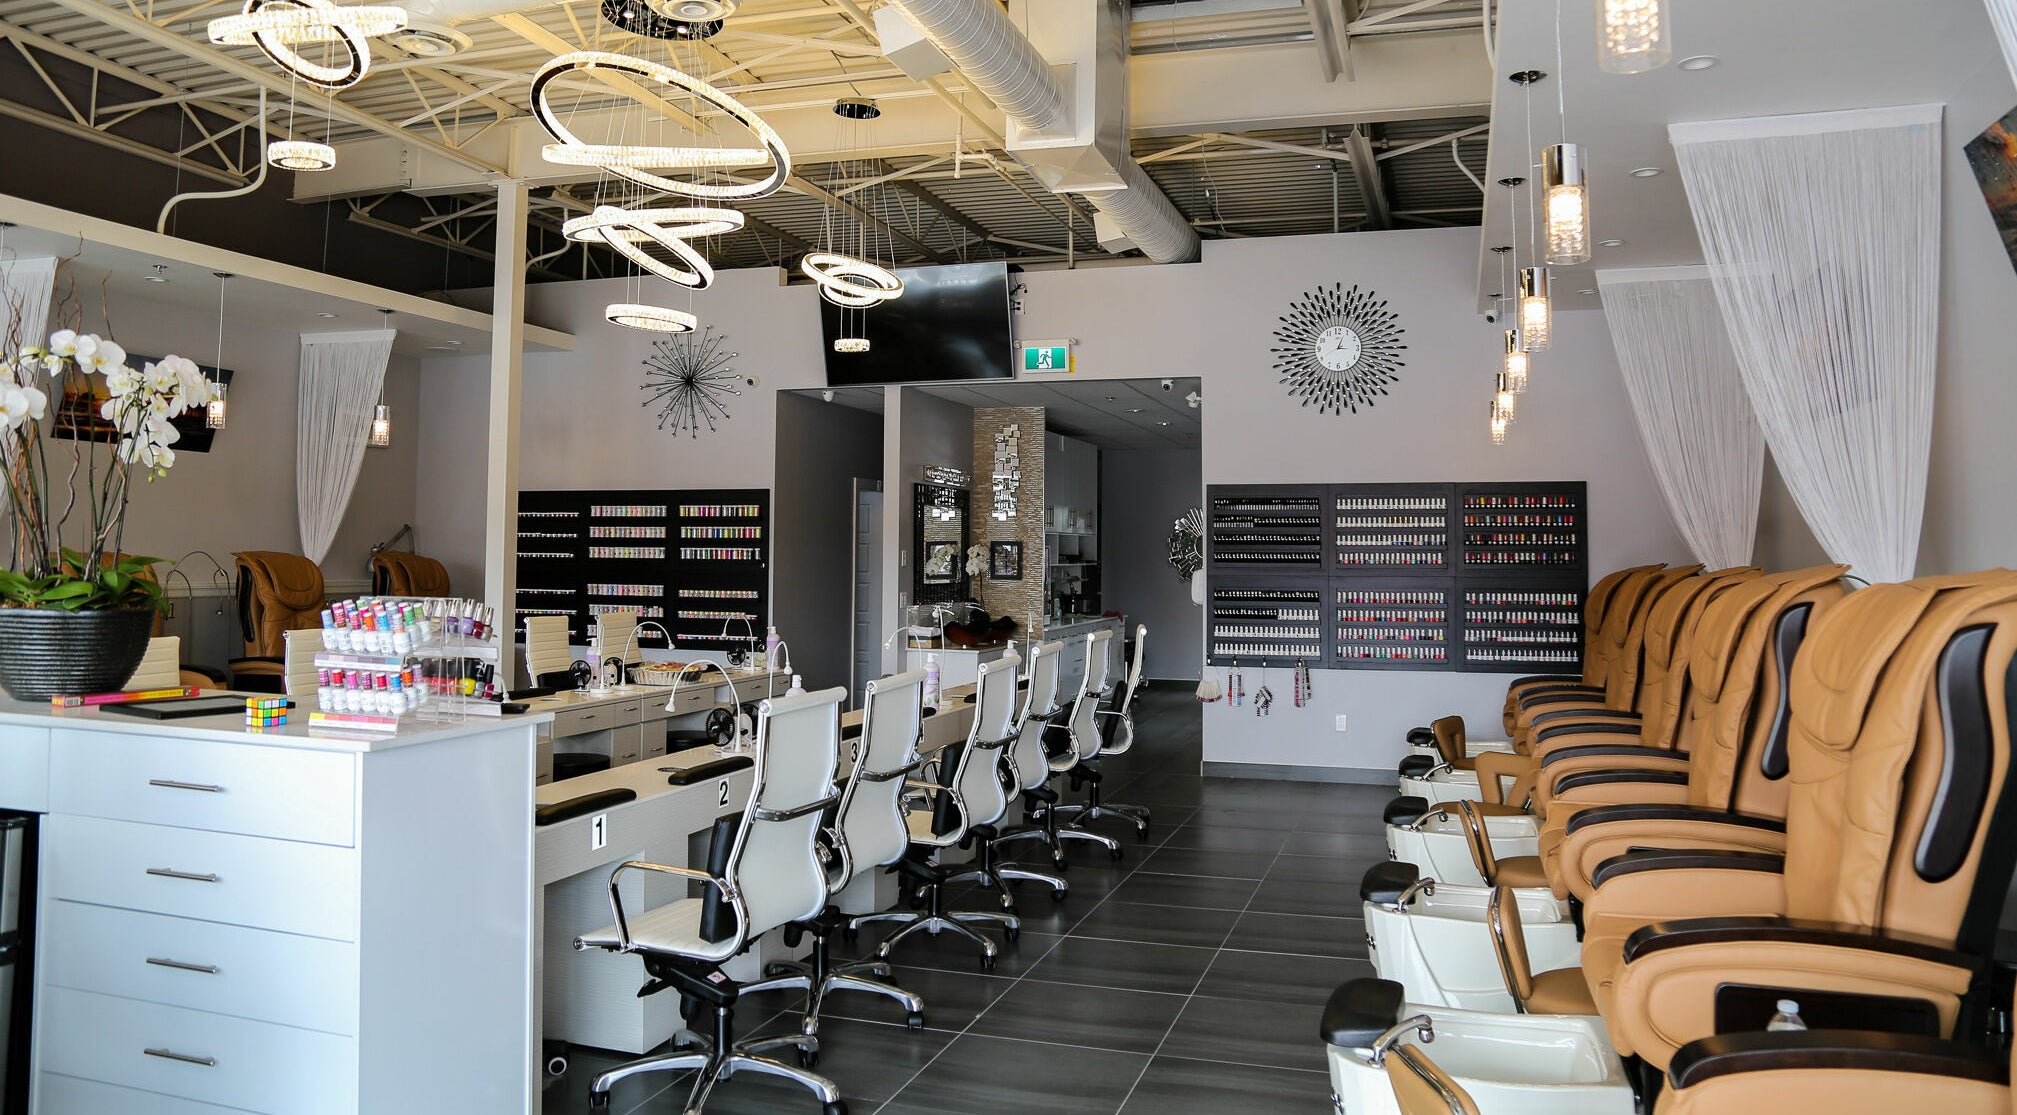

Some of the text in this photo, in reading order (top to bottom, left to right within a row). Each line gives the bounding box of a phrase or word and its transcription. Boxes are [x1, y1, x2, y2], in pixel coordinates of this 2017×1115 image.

[851, 742, 858, 763] 3
[719, 780, 729, 807] 2
[595, 817, 603, 846] 1
